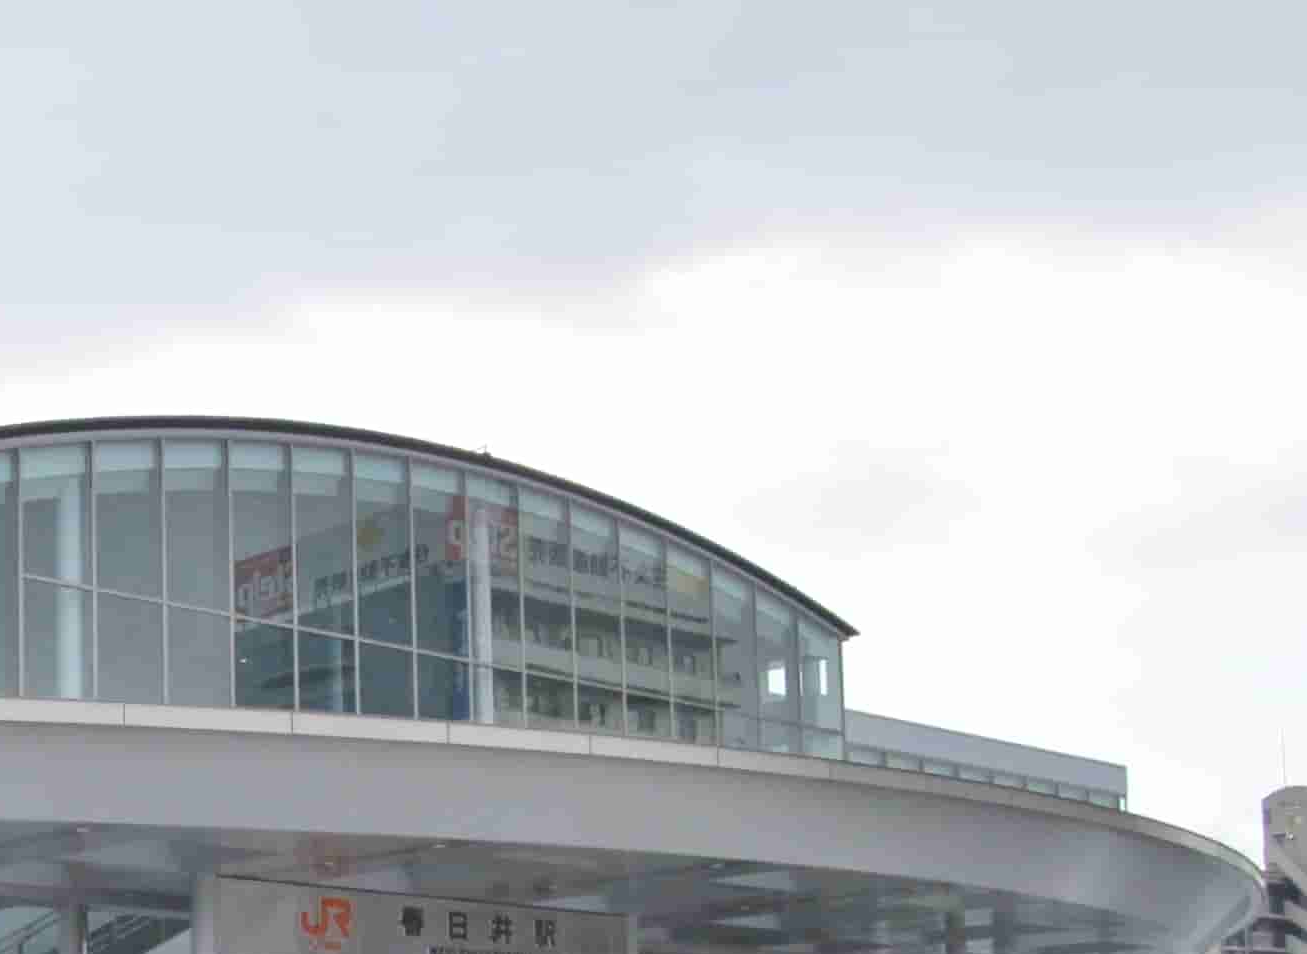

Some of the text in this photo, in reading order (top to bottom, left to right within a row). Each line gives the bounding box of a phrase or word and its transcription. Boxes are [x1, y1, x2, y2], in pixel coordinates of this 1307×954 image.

[300, 896, 354, 939] JR
[399, 905, 557, 950] 春日井駅
